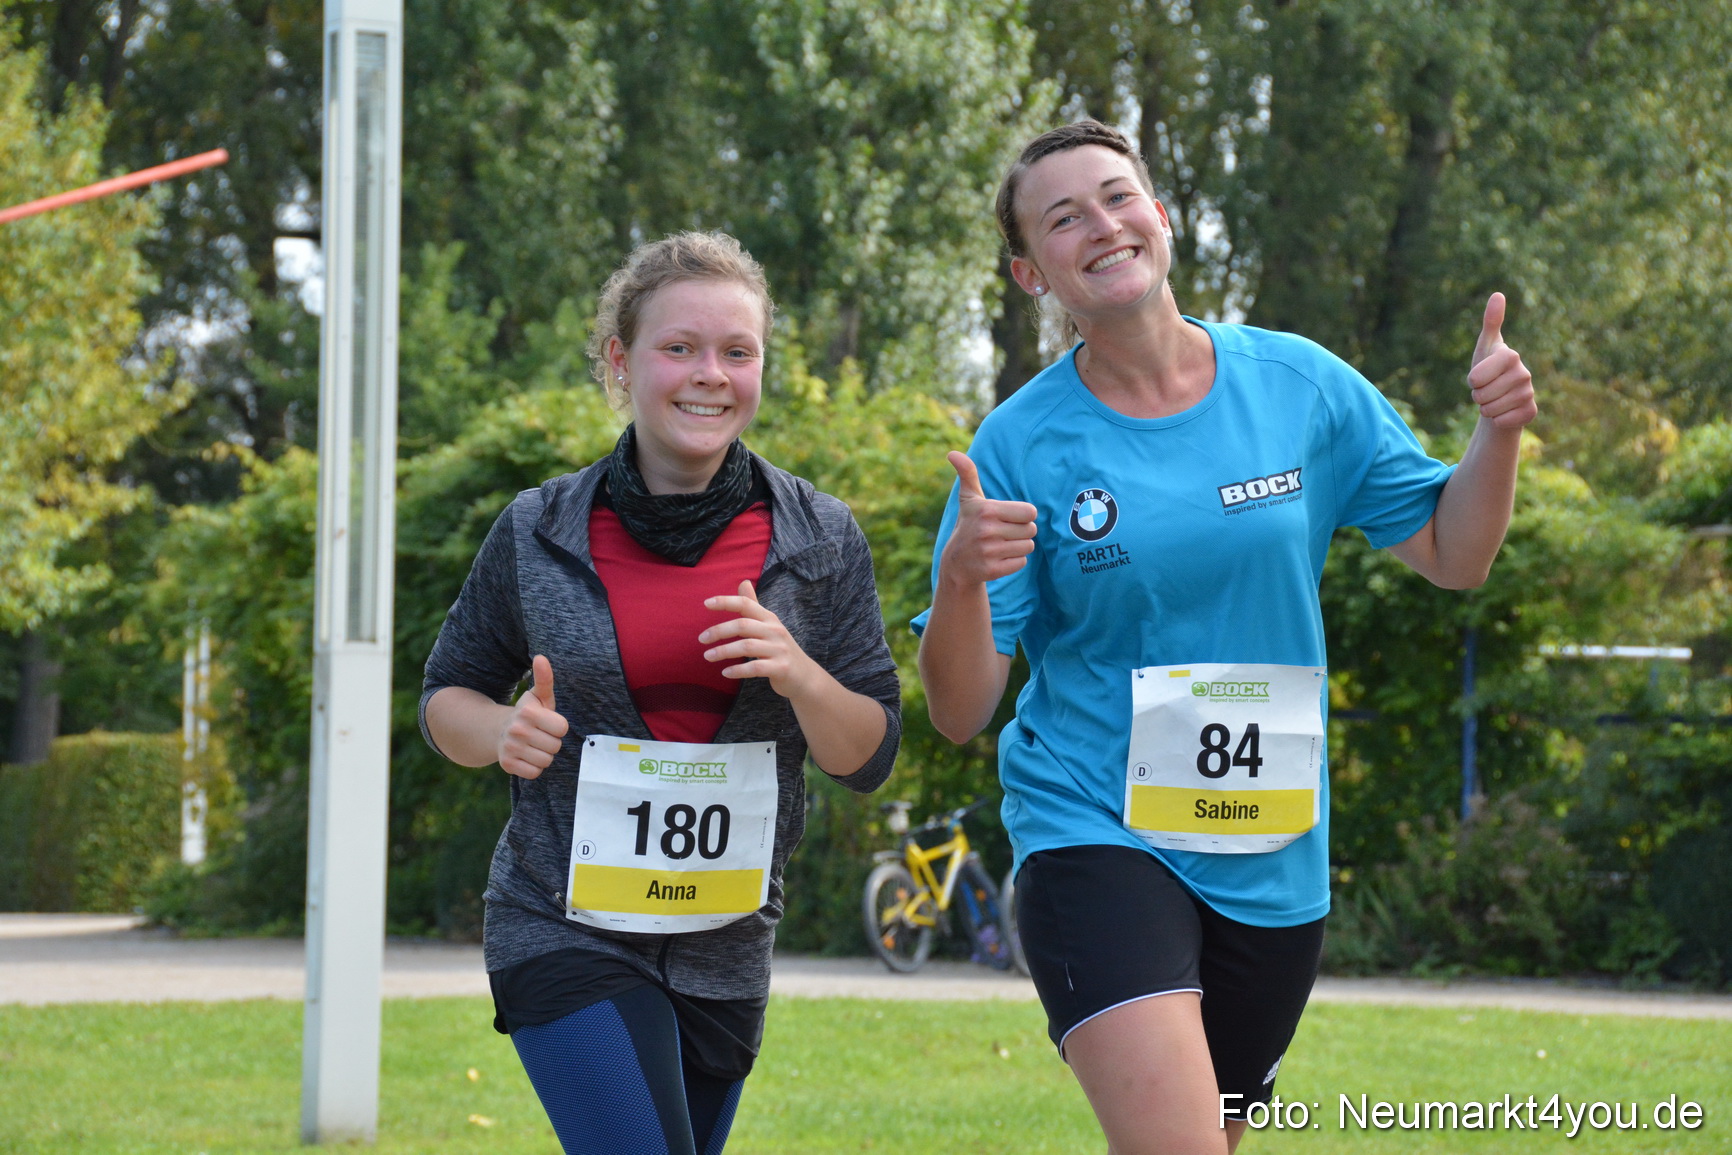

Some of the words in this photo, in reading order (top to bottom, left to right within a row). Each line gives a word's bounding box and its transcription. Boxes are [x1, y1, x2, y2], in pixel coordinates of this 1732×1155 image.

[1218, 467, 1302, 508] BOCK
[1074, 490, 1112, 512] BMW
[1224, 503, 1256, 516] inspired
[1269, 498, 1286, 506] smart
[1077, 543, 1128, 564] PARTL
[1080, 556, 1132, 574] Neumarkt
[1210, 682, 1270, 697] BOCK
[1196, 722, 1263, 778] 84
[660, 760, 727, 778] BOCK
[1138, 766, 1146, 776] D
[1194, 799, 1259, 820] Sabine
[627, 800, 730, 860] 180
[582, 845, 590, 855] D
[646, 880, 697, 900] Anna
